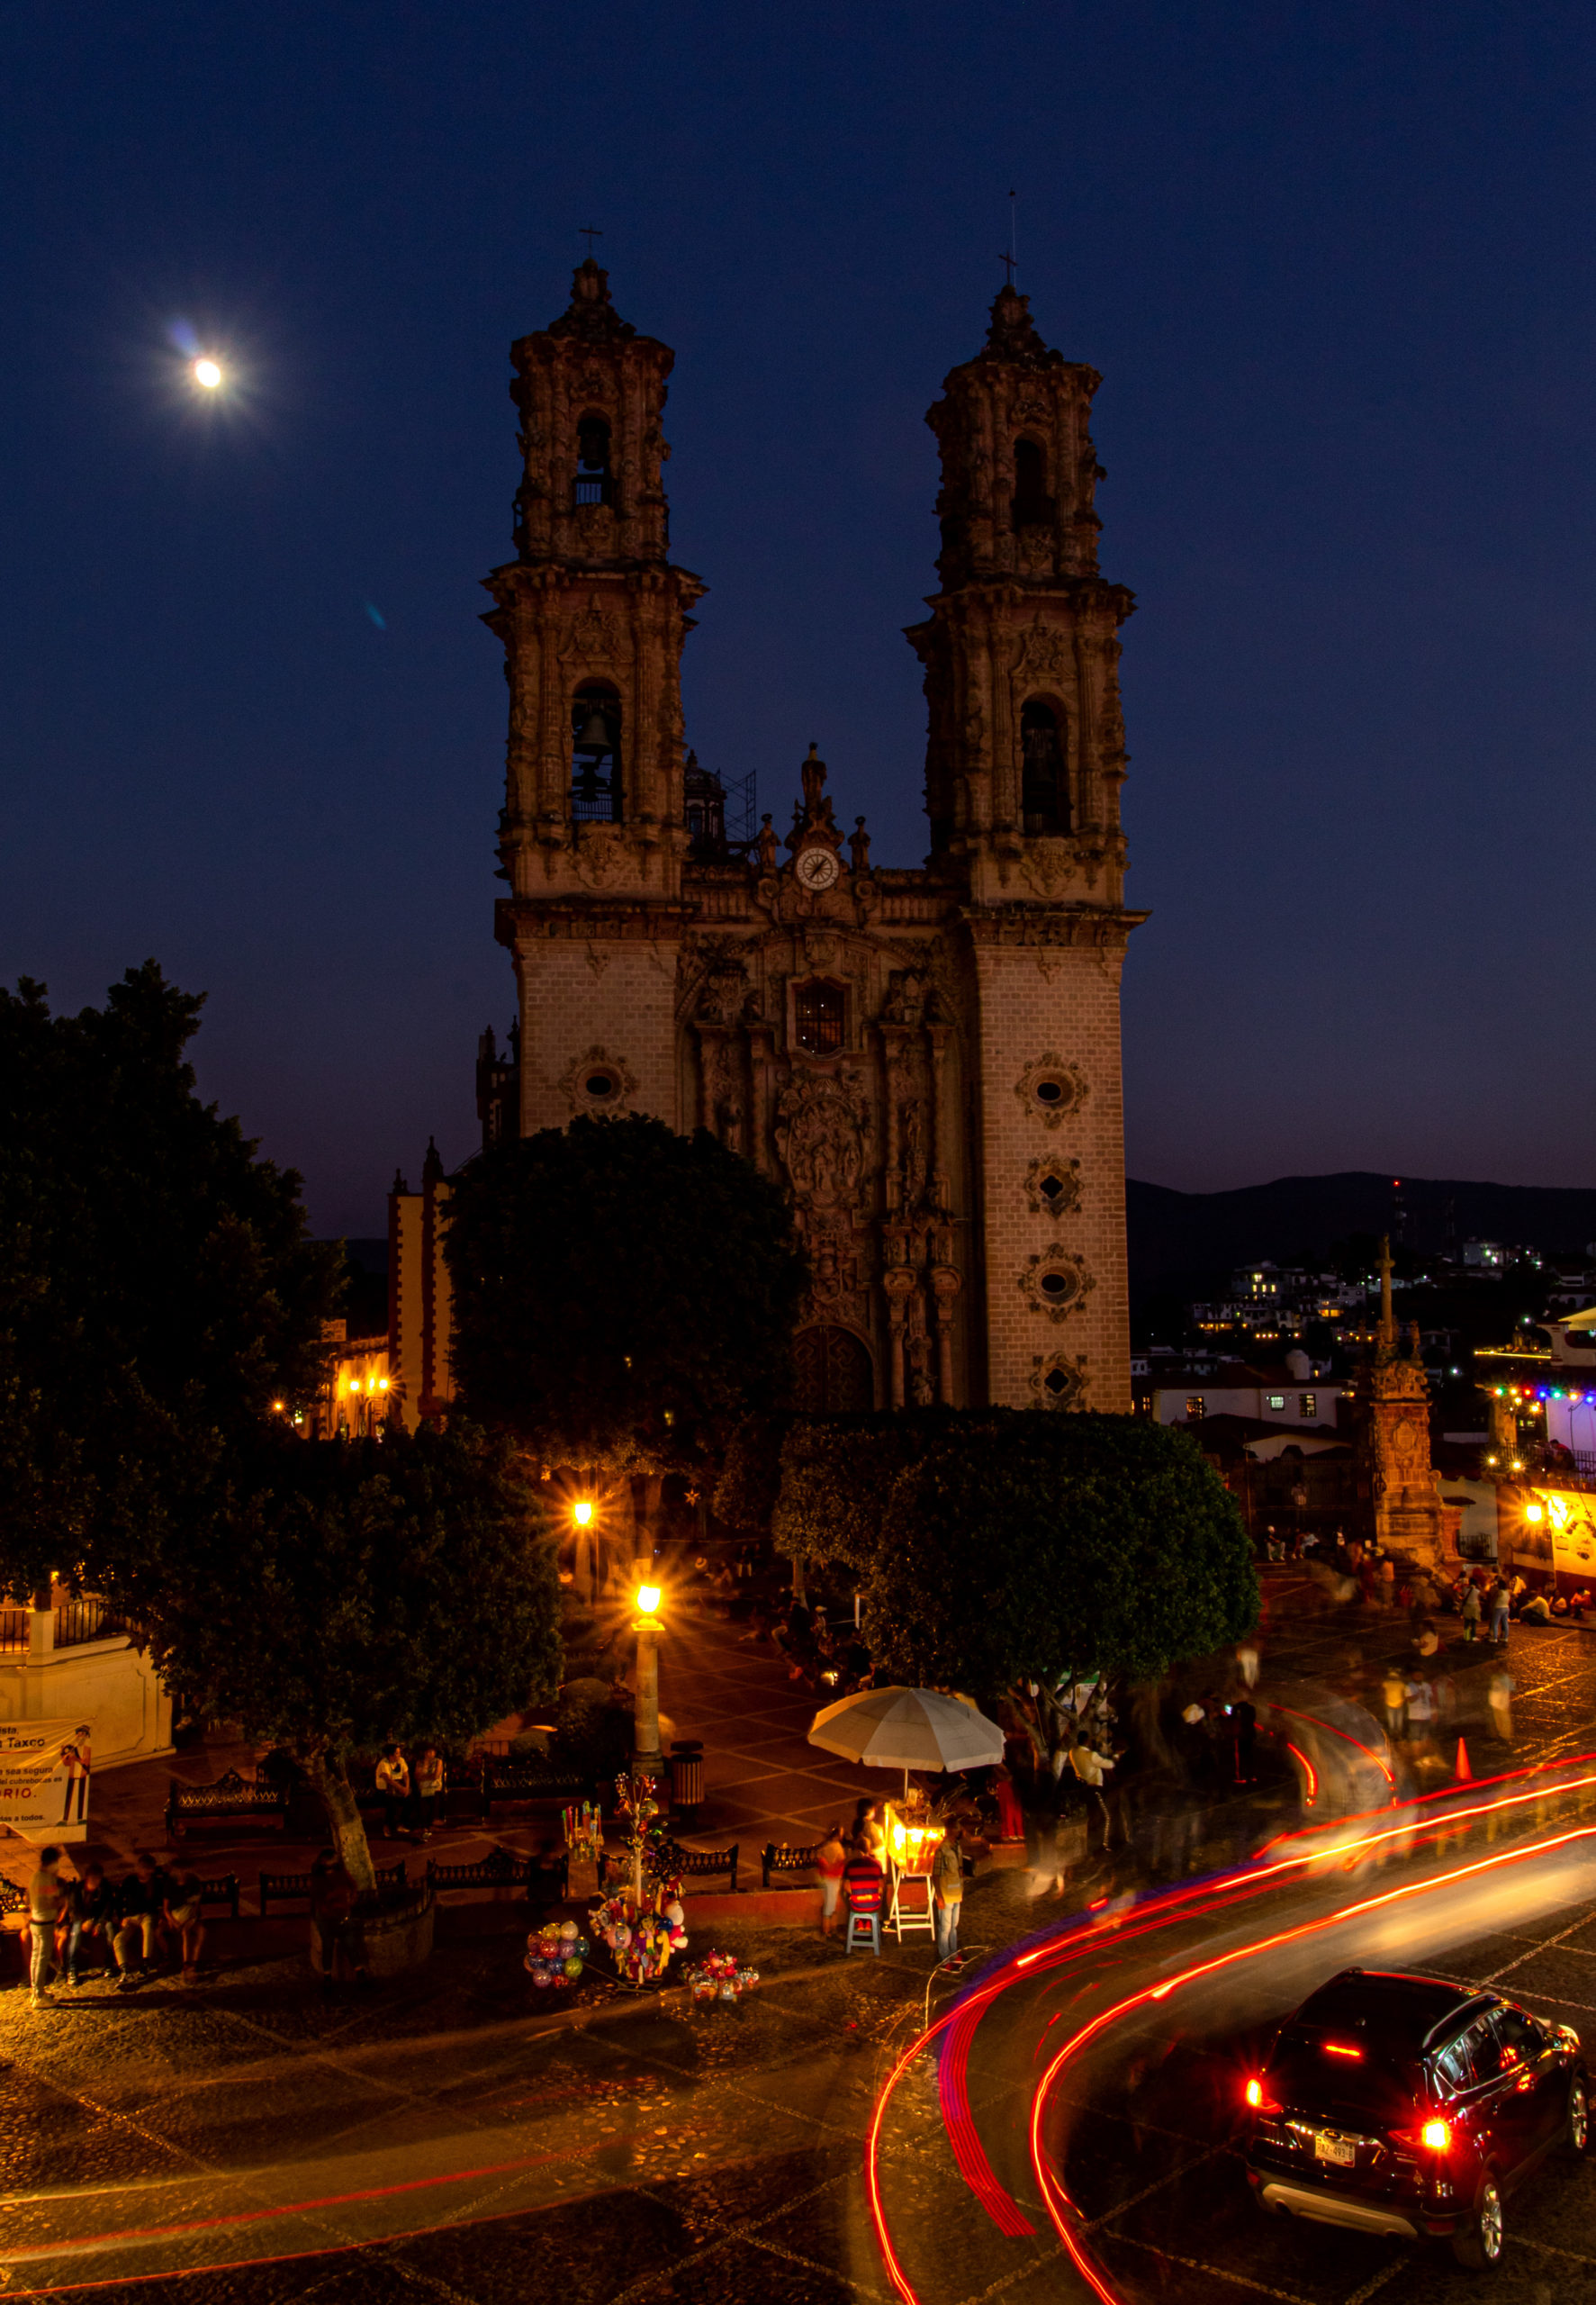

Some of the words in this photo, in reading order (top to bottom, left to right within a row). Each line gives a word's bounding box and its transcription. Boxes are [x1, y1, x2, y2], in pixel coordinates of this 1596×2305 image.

[7, 1737, 45, 1748] Taxco
[23, 1767, 53, 1776] segura
[0, 1787, 37, 1799] RIO.
[21, 1813, 46, 1821] todos.
